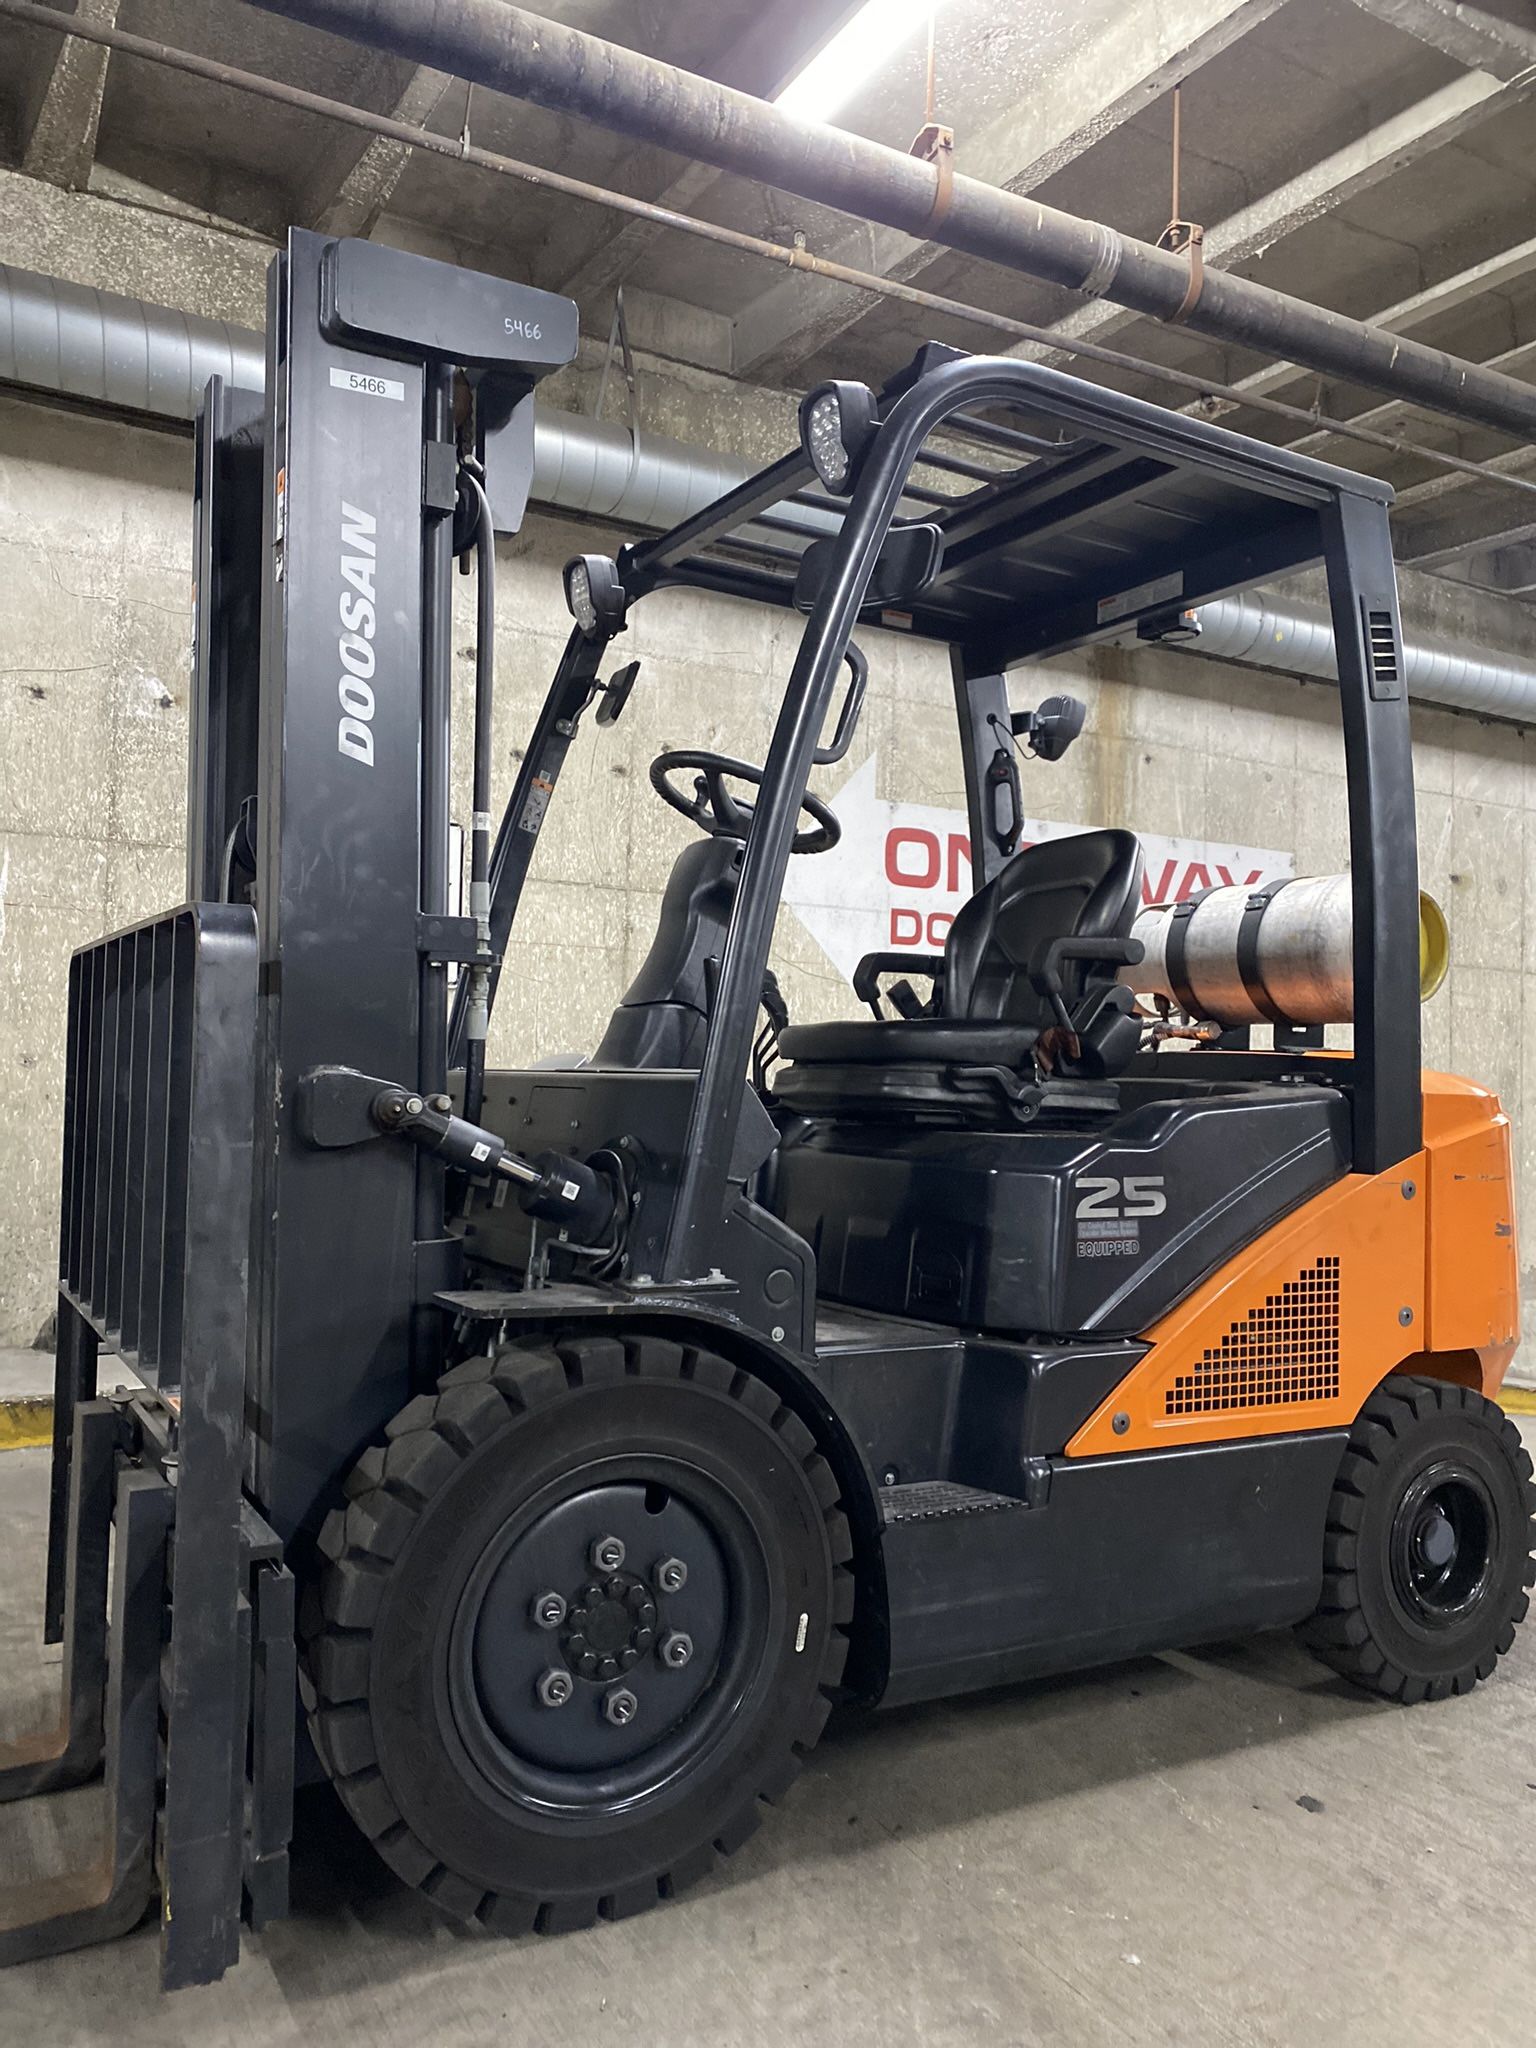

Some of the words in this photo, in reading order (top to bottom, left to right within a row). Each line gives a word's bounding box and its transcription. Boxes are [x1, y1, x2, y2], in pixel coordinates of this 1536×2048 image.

[504, 318, 542, 340] 5466
[349, 375, 386, 395] 5466
[338, 500, 376, 767] DOOSAN
[1075, 1176, 1167, 1219] 25
[1077, 1240, 1140, 1258] EQUIPPED
